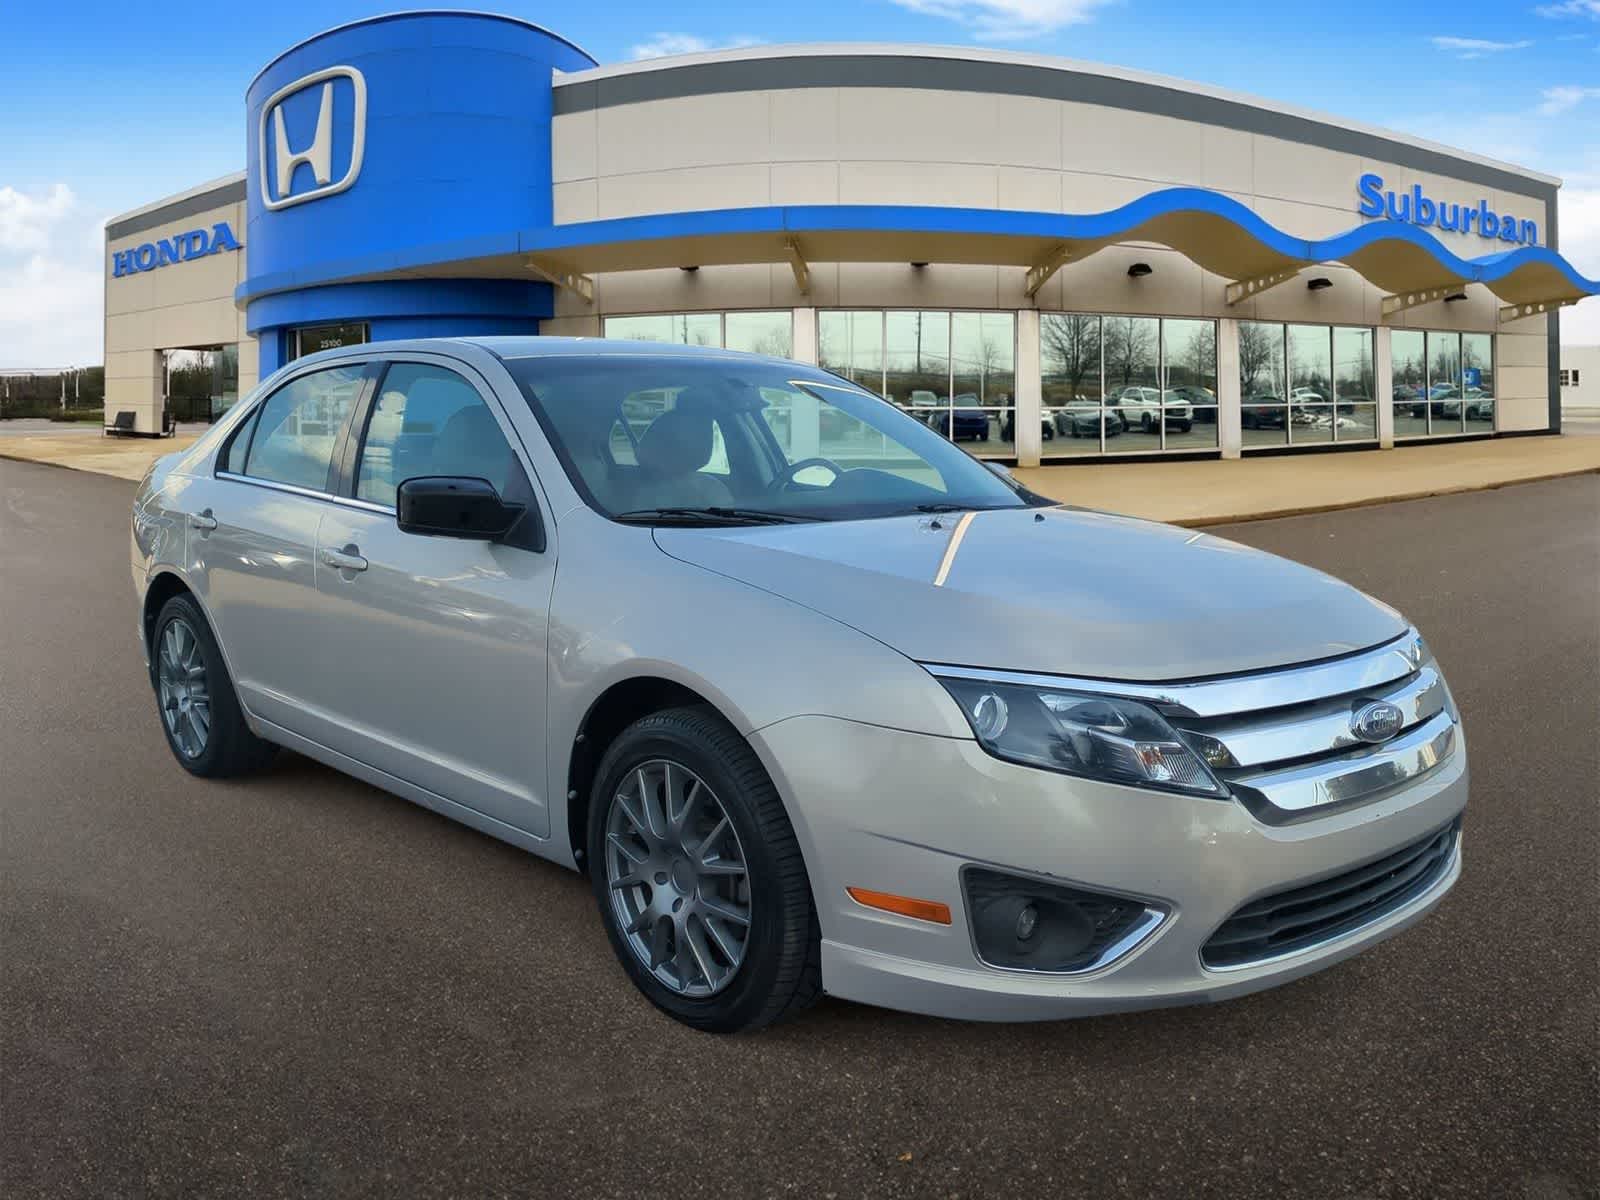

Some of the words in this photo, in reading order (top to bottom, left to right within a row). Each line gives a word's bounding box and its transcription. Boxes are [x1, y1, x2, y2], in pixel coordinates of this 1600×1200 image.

[1358, 173, 1537, 244] Suburban
[112, 222, 240, 278] HONDA
[1368, 708, 1398, 731] Ford
